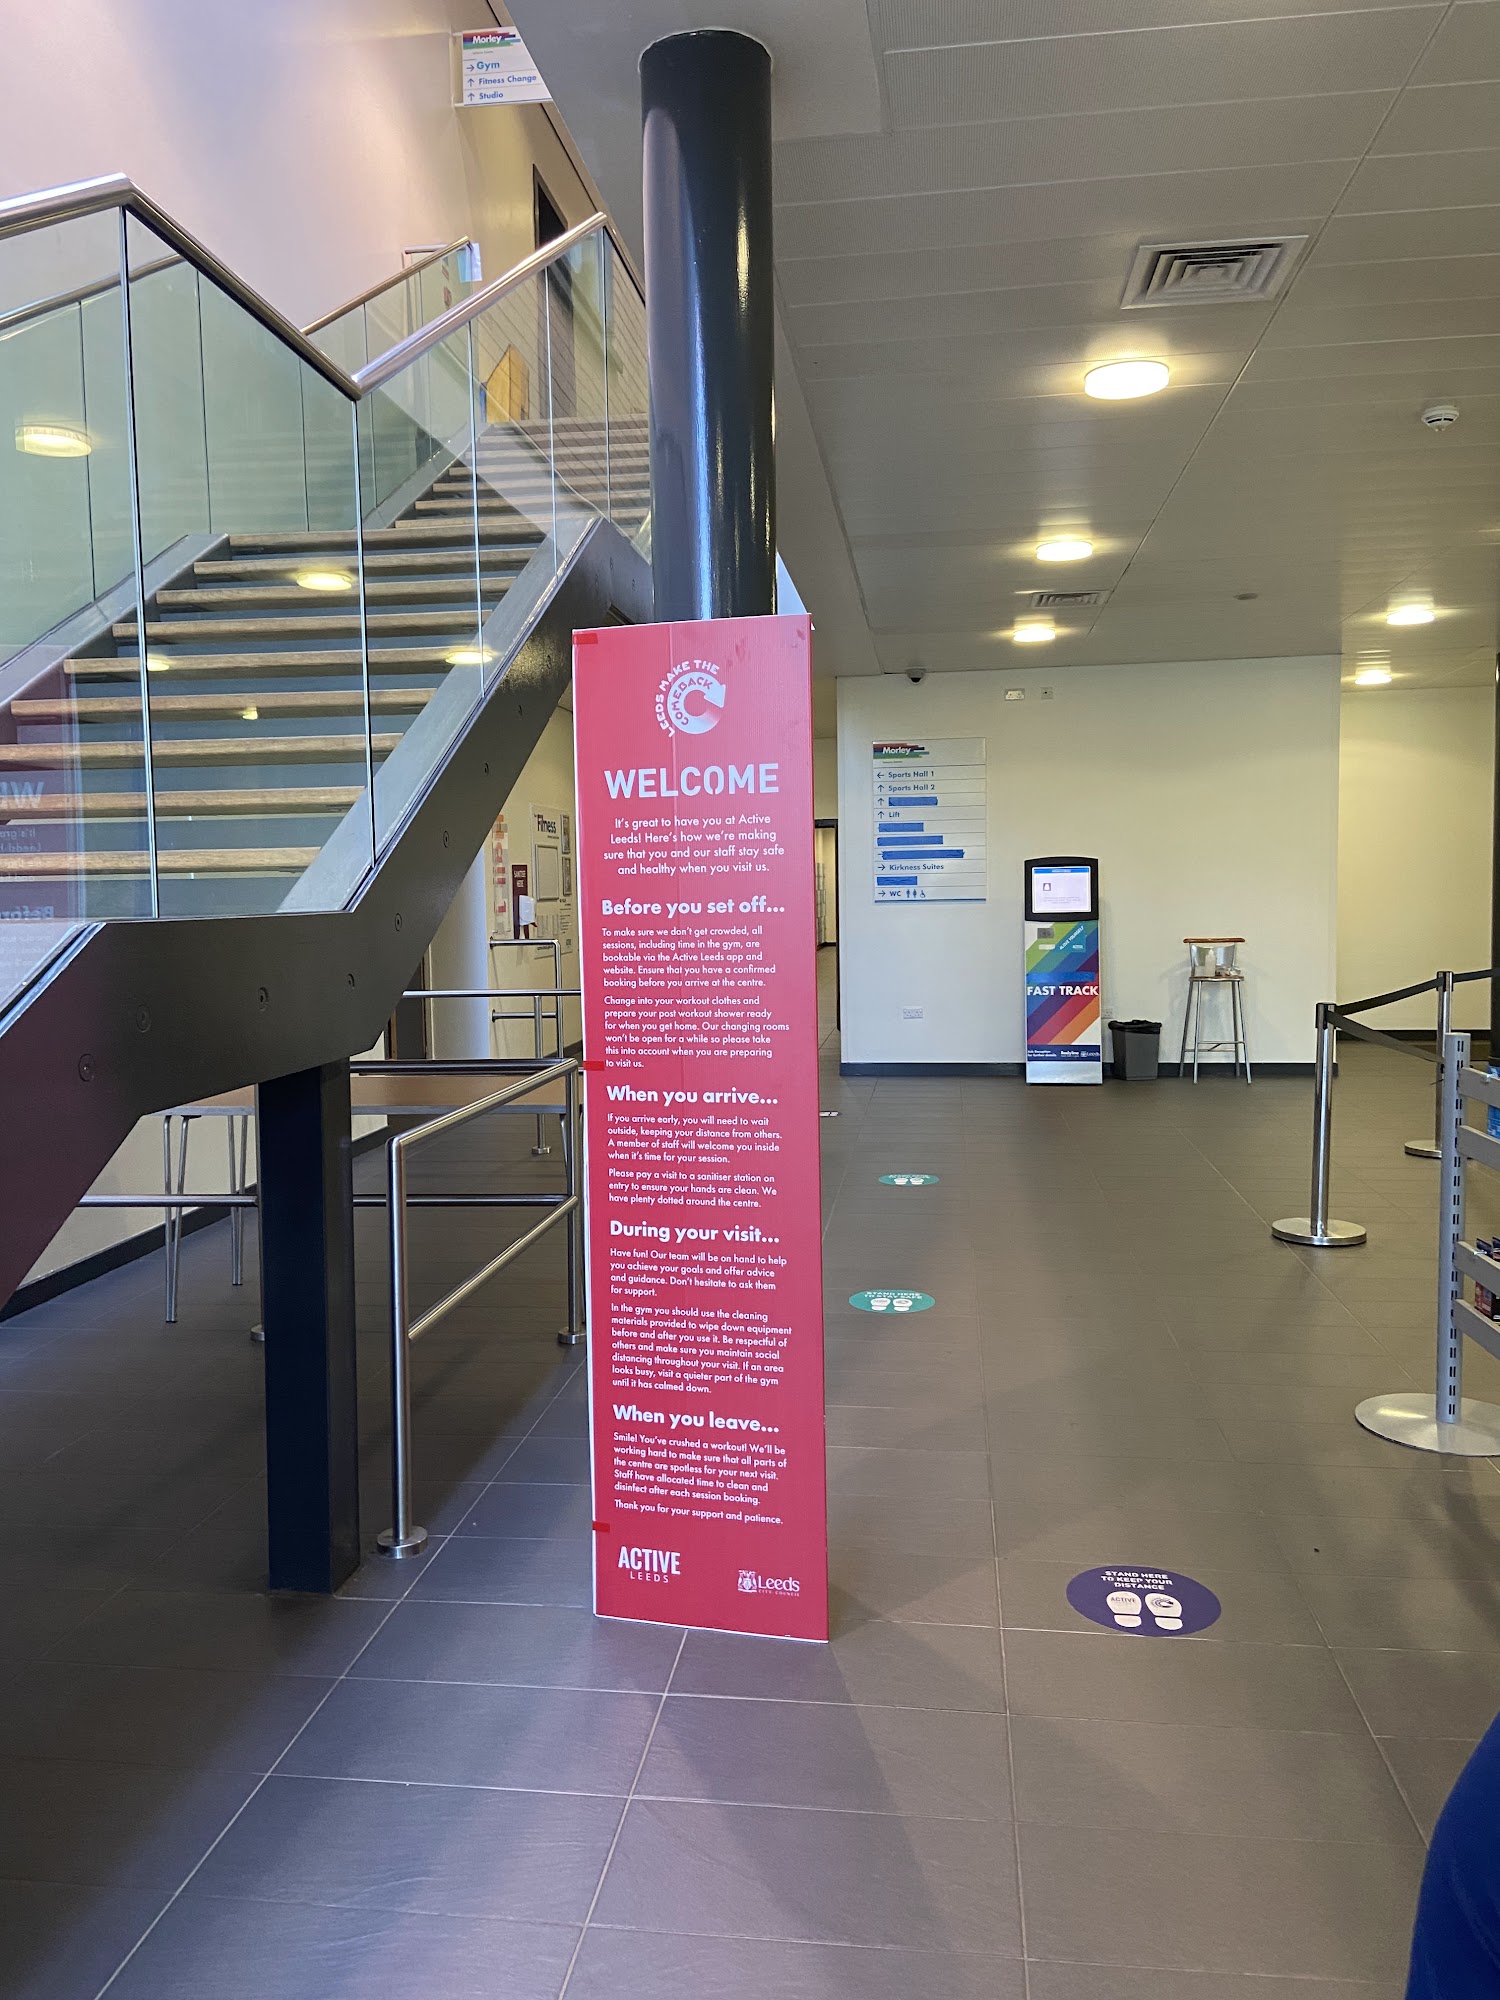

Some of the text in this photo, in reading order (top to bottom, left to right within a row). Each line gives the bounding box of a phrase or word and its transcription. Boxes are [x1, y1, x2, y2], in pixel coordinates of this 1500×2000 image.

[473, 35, 502, 44] Morley
[477, 62, 500, 71] Gym
[507, 75, 536, 83] Change
[655, 660, 719, 737] LEEDS MAKE THE
[671, 677, 713, 726] COMEBACK
[883, 746, 911, 755] Morley
[604, 763, 779, 799] WELCOME
[889, 771, 911, 779] Sports
[615, 814, 771, 831] It's great to have you at Active
[611, 828, 776, 844] Leeds! Here's how we're making
[604, 852, 624, 860] sure
[627, 848, 646, 859] that
[648, 851, 667, 862] you
[670, 846, 690, 858] and
[714, 845, 736, 857] staff
[739, 847, 759, 859] stay
[763, 844, 784, 856] safe
[618, 863, 637, 875] and
[640, 862, 676, 876] healthy
[679, 862, 707, 873] when
[710, 865, 729, 875] you
[732, 862, 752, 872] visit
[602, 895, 785, 919] Before you set off...
[602, 928, 612, 936] To
[614, 927, 635, 937] make
[670, 926, 692, 936] don't
[694, 928, 708, 938] get
[710, 925, 749, 936] crowded,
[752, 925, 762, 934] all
[602, 940, 636, 950] sessions,
[639, 939, 676, 951] including
[678, 939, 695, 948] time
[697, 940, 705, 948] in
[707, 939, 720, 948] the
[722, 942, 743, 950] gym,
[604, 977, 766, 989] booking before you arrive at the centre.
[1027, 986, 1099, 996] FAST TRACK
[606, 1085, 778, 1107] When you arrive...
[607, 1126, 782, 1139] outside, keeping your distance from others.
[610, 1220, 779, 1243] During your visit...
[610, 1248, 631, 1257] Have
[633, 1248, 648, 1258] fun!
[650, 1250, 667, 1259] Our
[669, 1252, 689, 1260] team
[691, 1252, 705, 1261] will
[708, 1252, 719, 1262] be
[734, 1254, 755, 1264] hand
[757, 1256, 766, 1264] to
[768, 1255, 787, 1267] help
[611, 1284, 657, 1297] for support.
[613, 1404, 779, 1433] When you leave...
[613, 1432, 638, 1443] Smile!
[639, 1434, 667, 1445] You've
[669, 1438, 700, 1448] crushed
[710, 1441, 747, 1452] workout!
[749, 1444, 772, 1454] We'll
[774, 1445, 786, 1455] be
[614, 1481, 760, 1506] disinfect after each session booking.
[615, 1499, 783, 1524] Thank you for your support and patience.
[618, 1546, 680, 1575] ACTIVE
[630, 1571, 669, 1583] LEEDS
[758, 1576, 799, 1592] Leeds
[1115, 1582, 1165, 1590] DISTANCE
